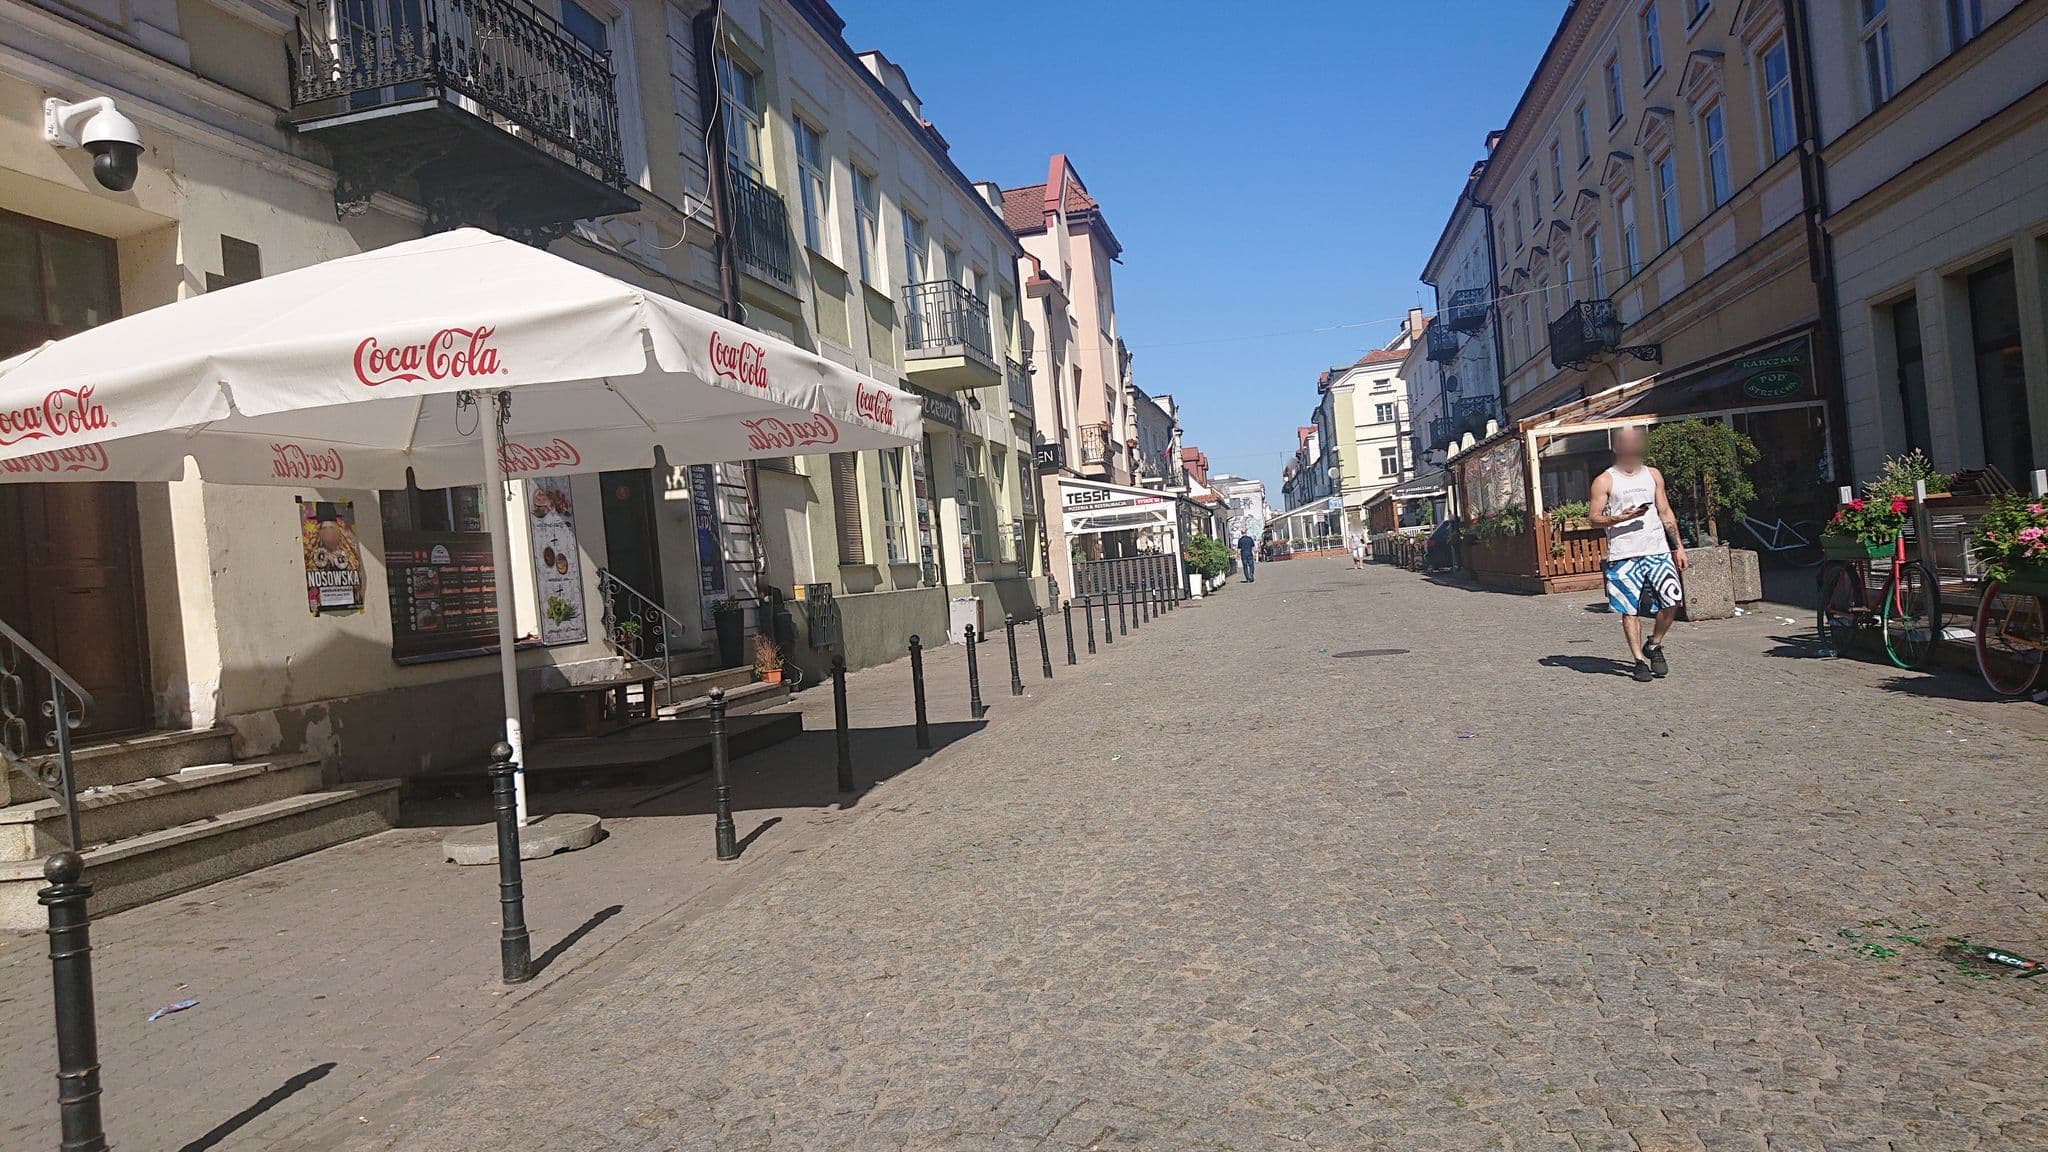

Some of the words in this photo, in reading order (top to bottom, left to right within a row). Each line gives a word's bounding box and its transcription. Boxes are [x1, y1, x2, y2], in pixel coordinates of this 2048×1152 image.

[353, 324, 500, 387] Coca-Cola
[710, 331, 768, 388] Coca-Cola
[1760, 374, 1786, 383] POD
[0, 384, 108, 446] oca-Cola
[856, 382, 893, 426] Coca-Cola
[1066, 489, 1111, 504] TESSA
[307, 571, 360, 587] NOSOWSKA
